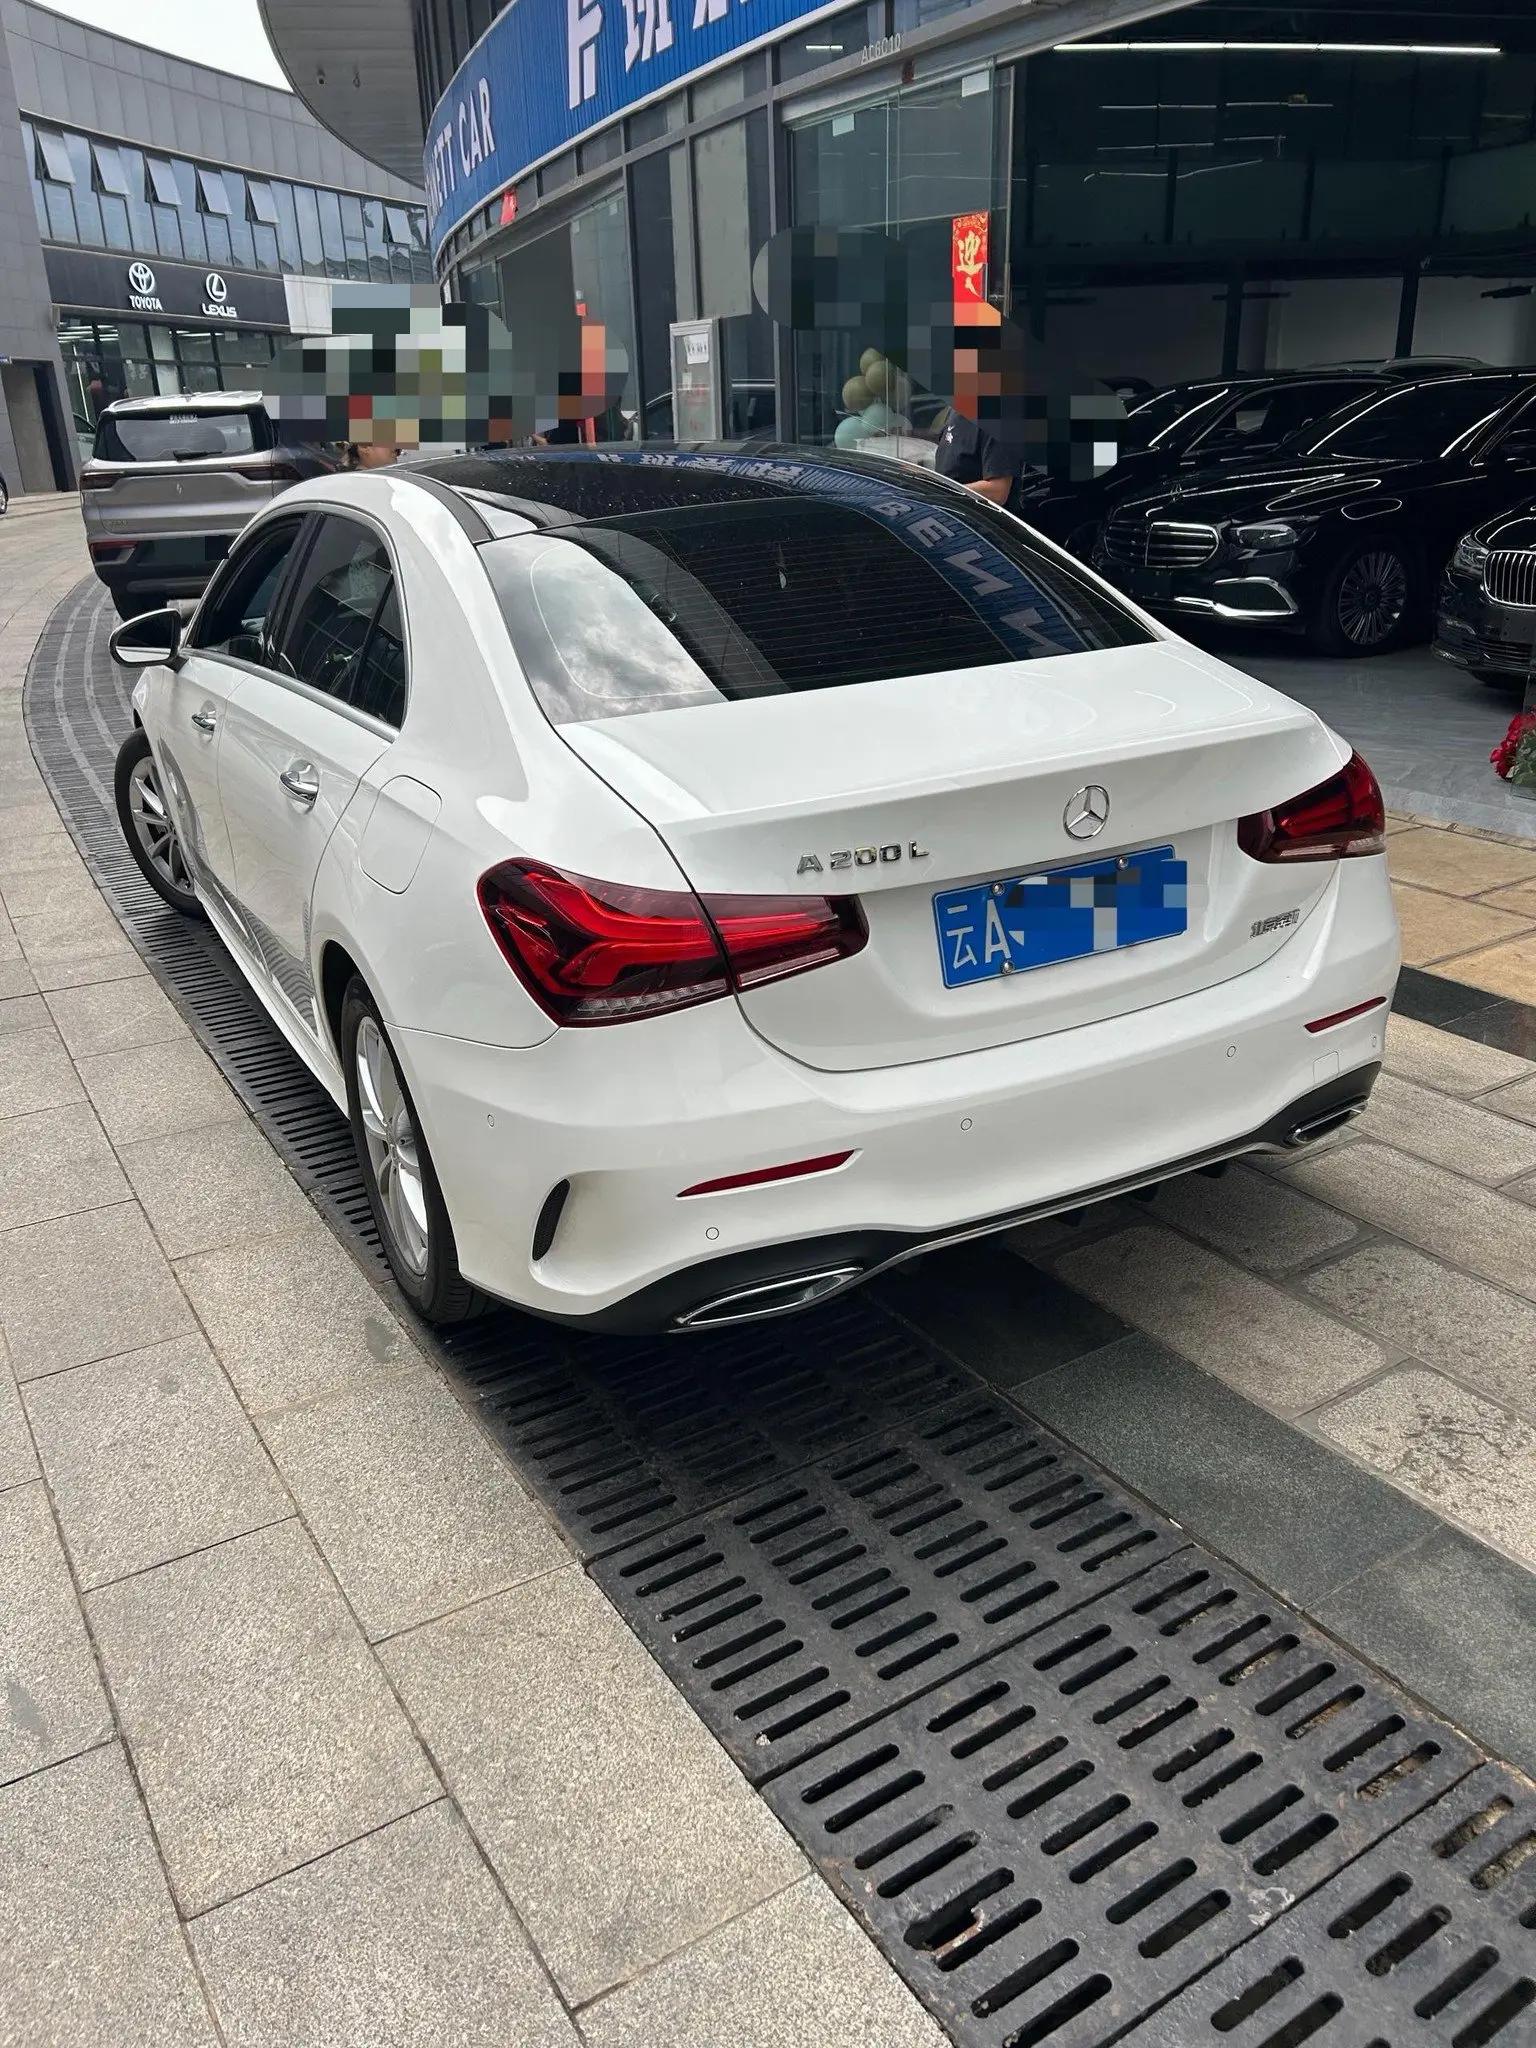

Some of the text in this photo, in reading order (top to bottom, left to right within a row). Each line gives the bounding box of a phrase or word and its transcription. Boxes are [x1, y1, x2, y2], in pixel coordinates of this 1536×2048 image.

[459, 77, 495, 178] CAR
[129, 295, 164, 312] TOYOTA
[201, 303, 237, 318] LEXUS
